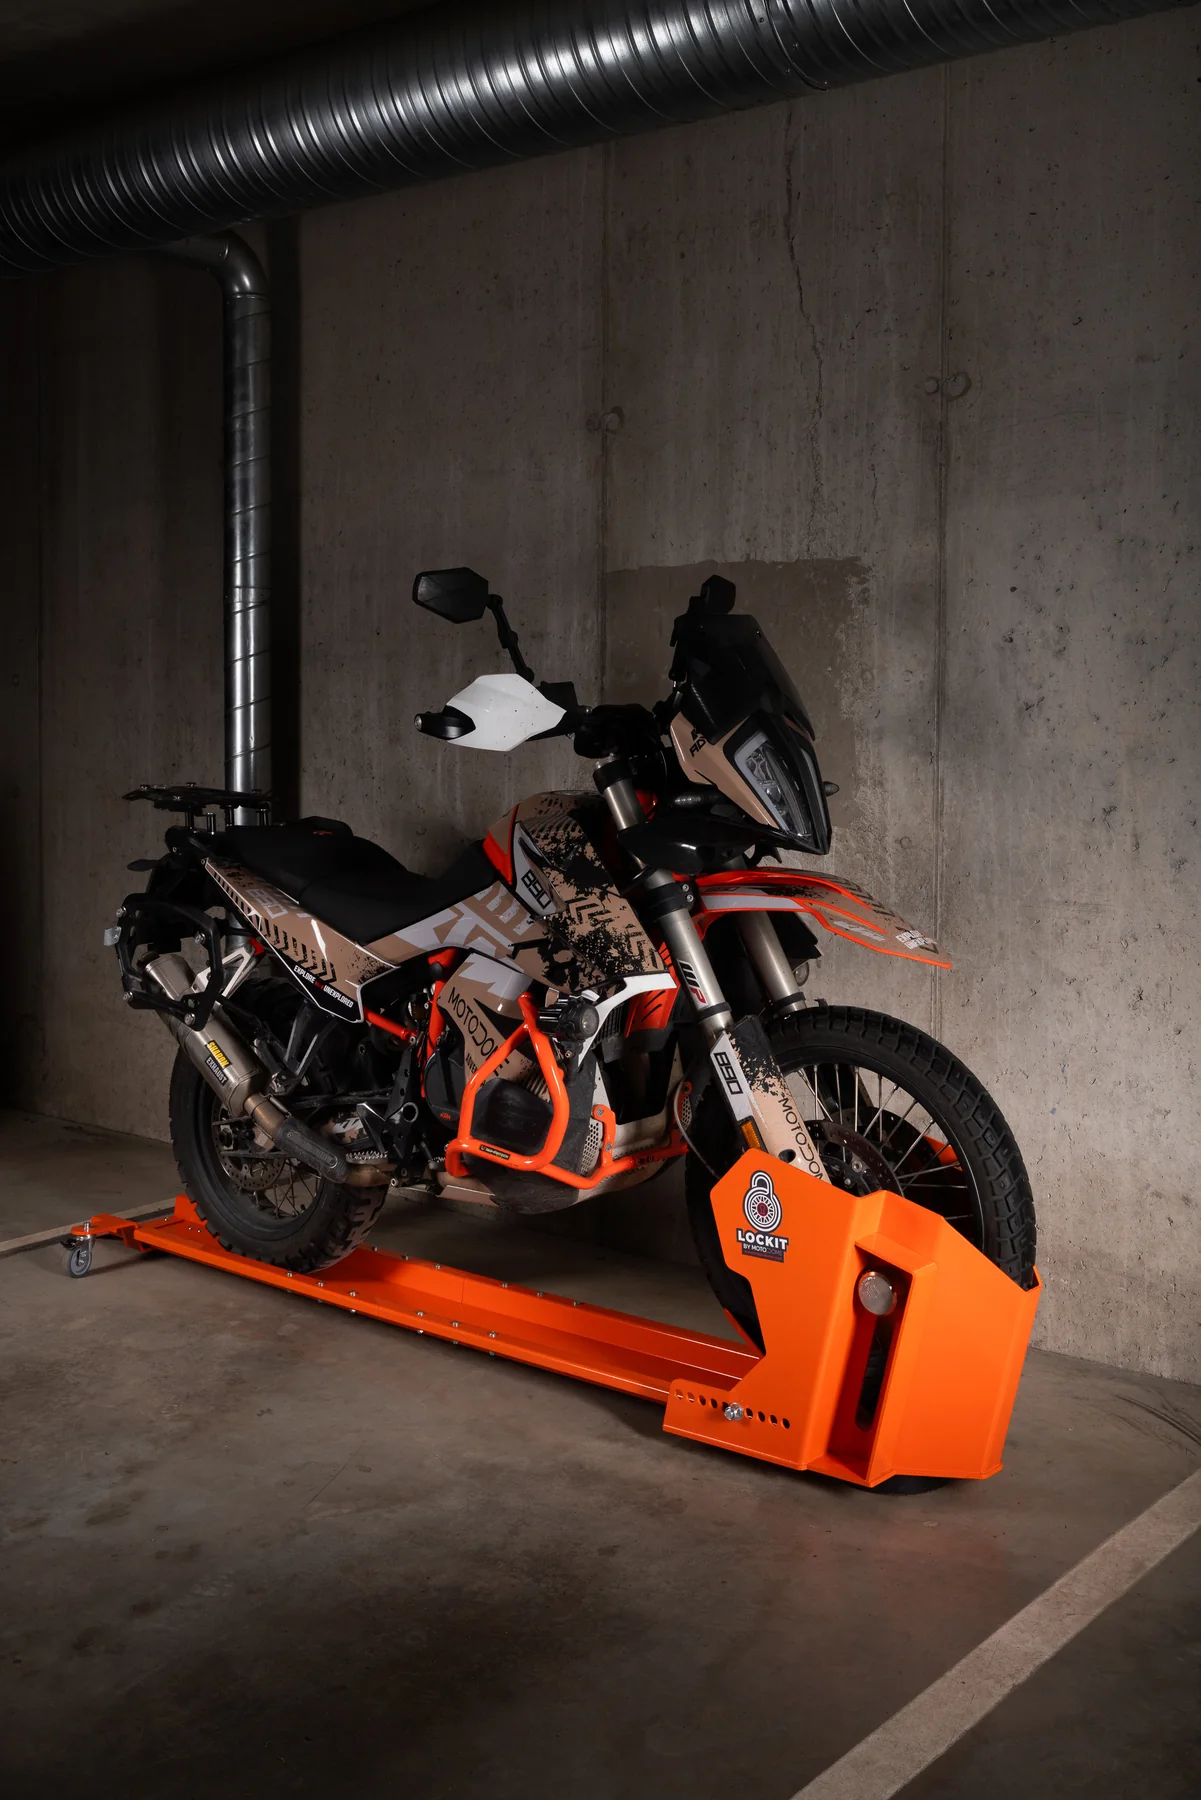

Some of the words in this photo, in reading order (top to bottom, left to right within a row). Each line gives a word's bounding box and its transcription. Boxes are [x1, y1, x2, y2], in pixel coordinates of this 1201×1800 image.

[245, 888, 288, 918] 890
[521, 869, 552, 909] 890
[293, 964, 317, 984] EXPLORE
[323, 984, 354, 1008] UNEXPLORED
[206, 1057, 227, 1083] EXHAUST
[714, 1052, 743, 1094] 890
[737, 1230, 787, 1250] LOCKIT
